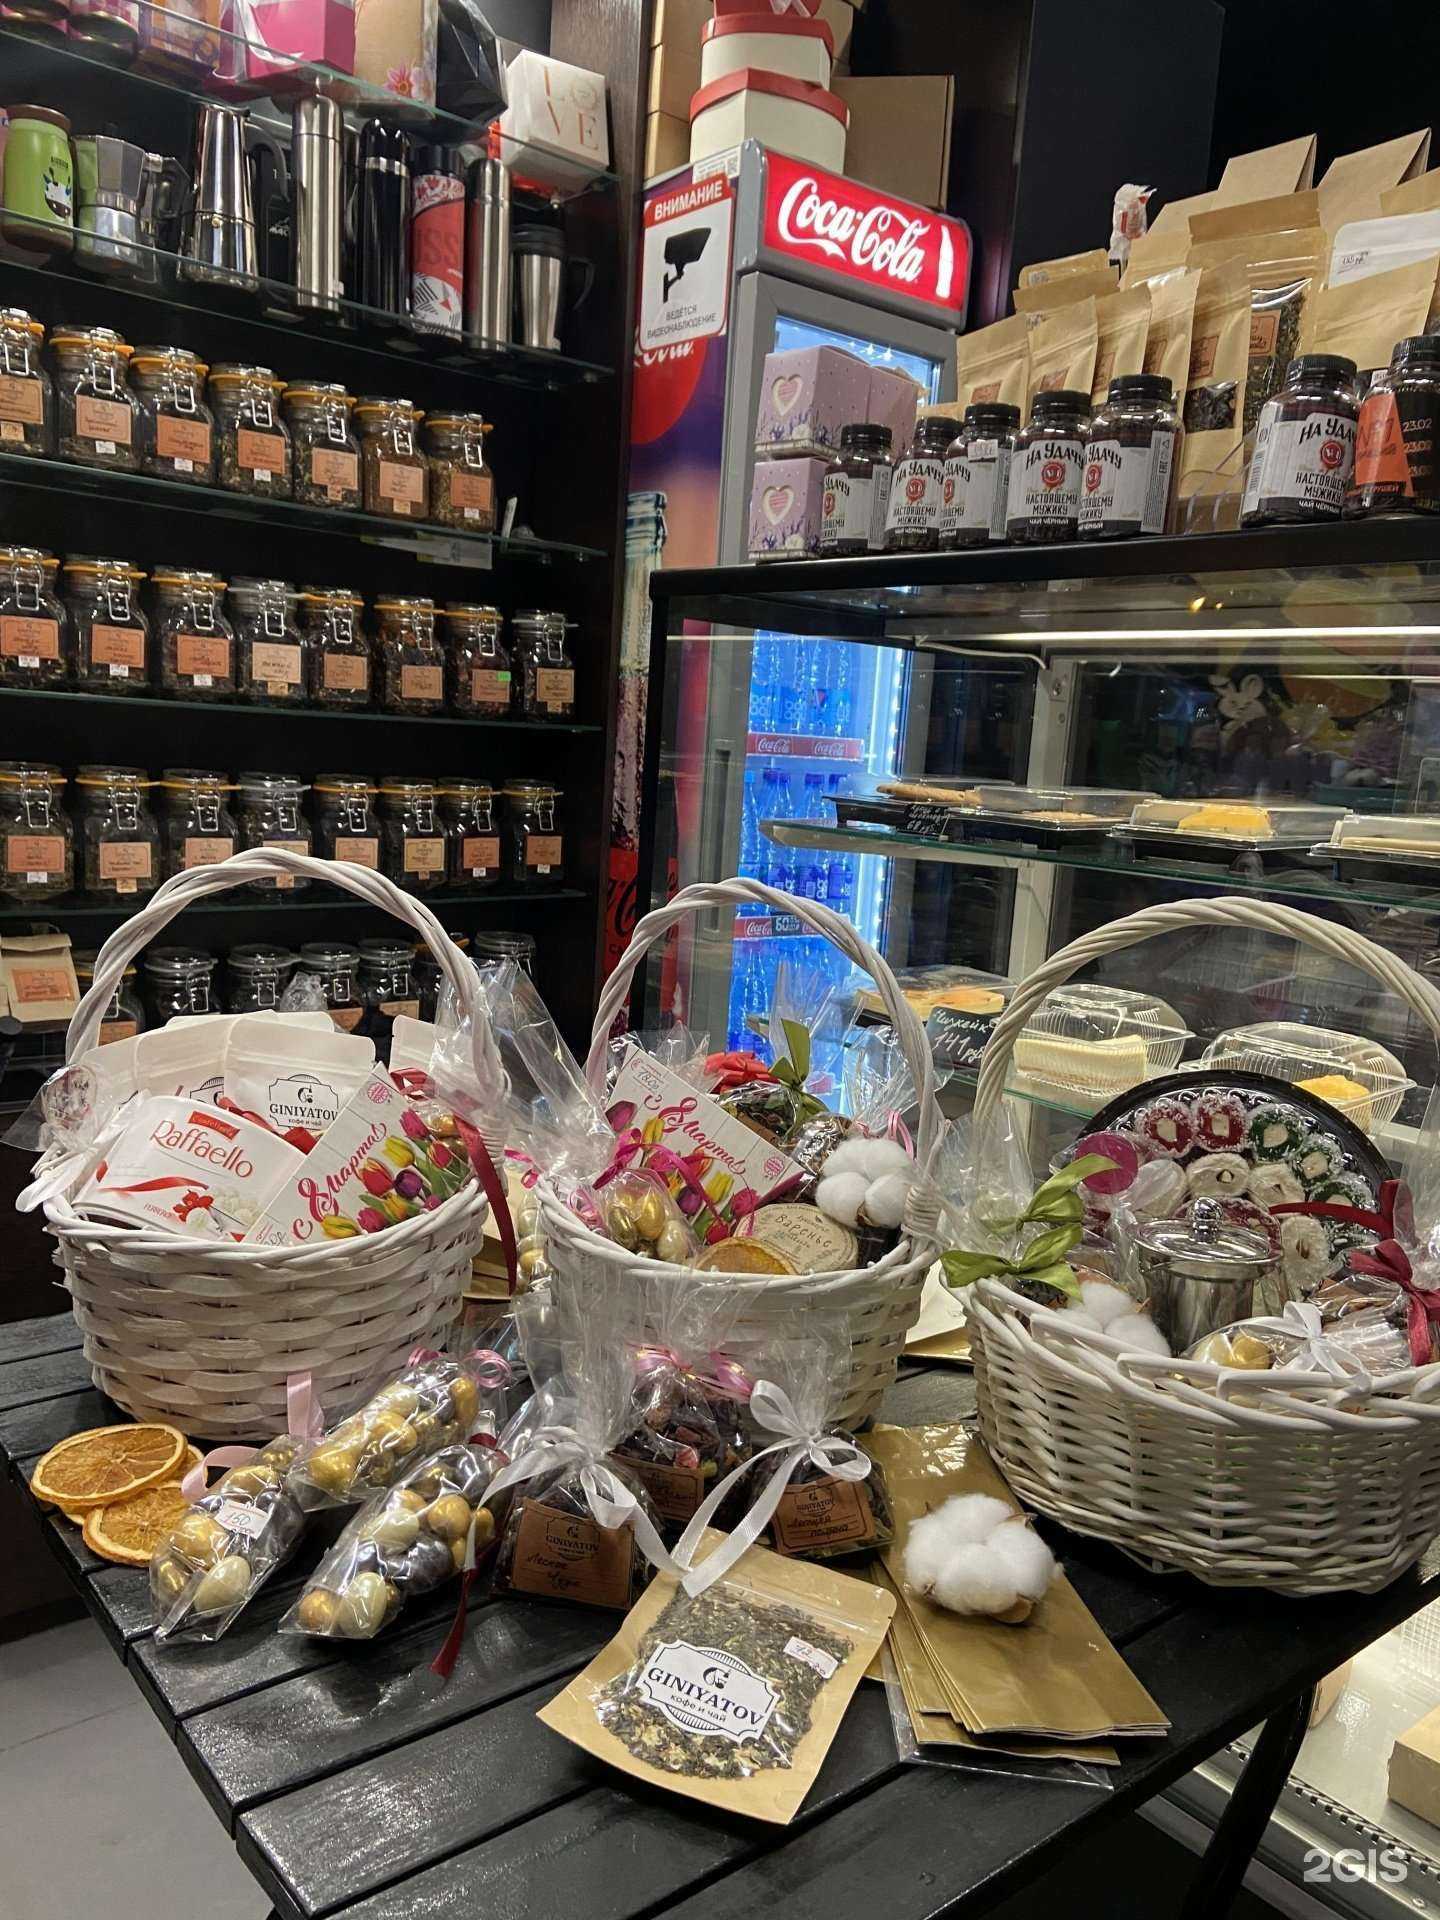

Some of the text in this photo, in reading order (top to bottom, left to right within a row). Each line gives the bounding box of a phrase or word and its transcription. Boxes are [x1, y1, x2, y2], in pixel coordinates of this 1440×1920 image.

[654, 181, 723, 219] ВНИМАНИЕ
[1044, 442, 1085, 469] УДАЧУ
[1025, 494, 1078, 506] НАСТОЯЩЕМУ
[1033, 505, 1068, 516] МУЖИКУ
[269, 1103, 339, 1122] GINIYATOV
[149, 1119, 254, 1178] Raffaello
[298, 1177, 340, 1223] 8
[648, 1667, 764, 1726] GINIYATOV
[670, 1694, 727, 1723] кофе и чай
